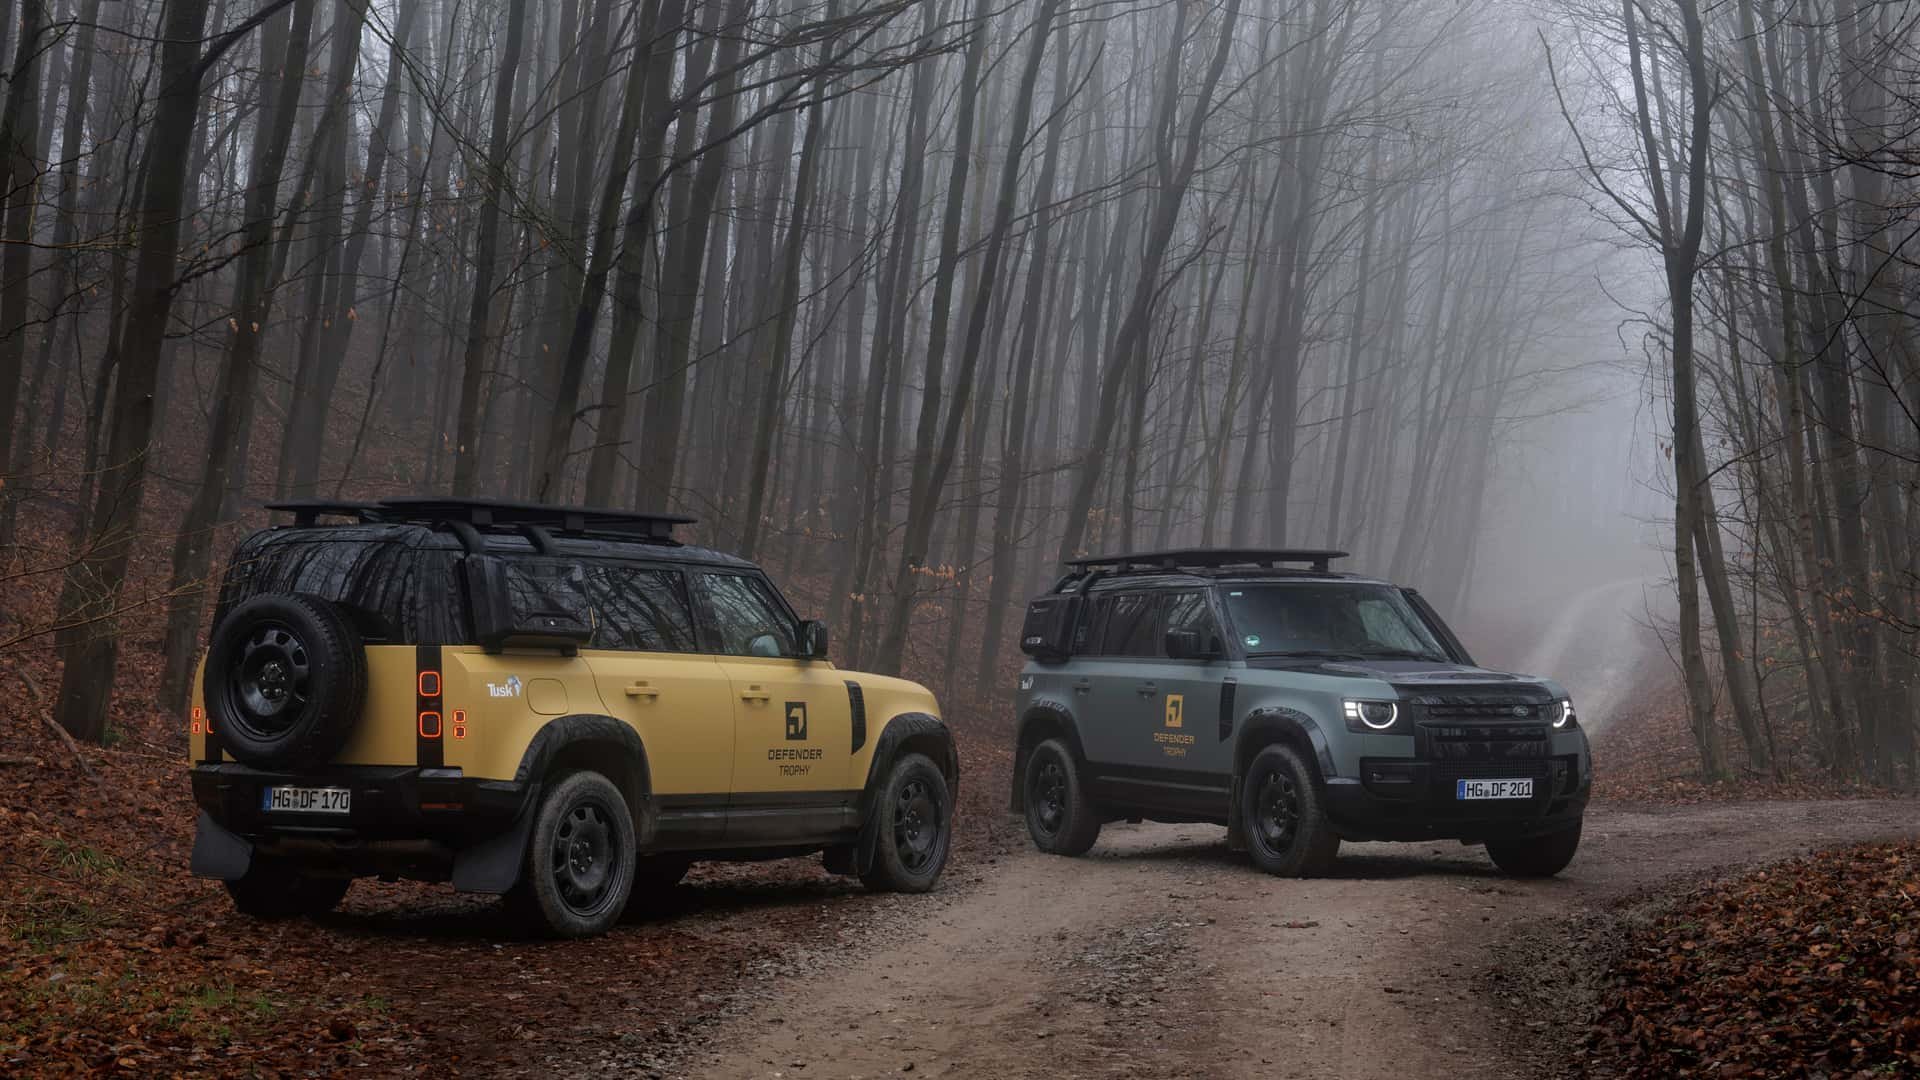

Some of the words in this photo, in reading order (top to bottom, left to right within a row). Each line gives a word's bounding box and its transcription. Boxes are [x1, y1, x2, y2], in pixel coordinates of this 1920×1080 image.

[488, 683, 513, 697] Tusk
[1153, 732, 1195, 745] DEFENDER
[768, 749, 822, 760] DEFENDER
[779, 765, 810, 776] TROPHY
[1467, 783, 1483, 797] HG
[1491, 783, 1508, 797] DF
[1510, 782, 1532, 796] 201
[272, 790, 291, 808] HG
[300, 791, 319, 808] DF
[321, 791, 349, 809] 170
